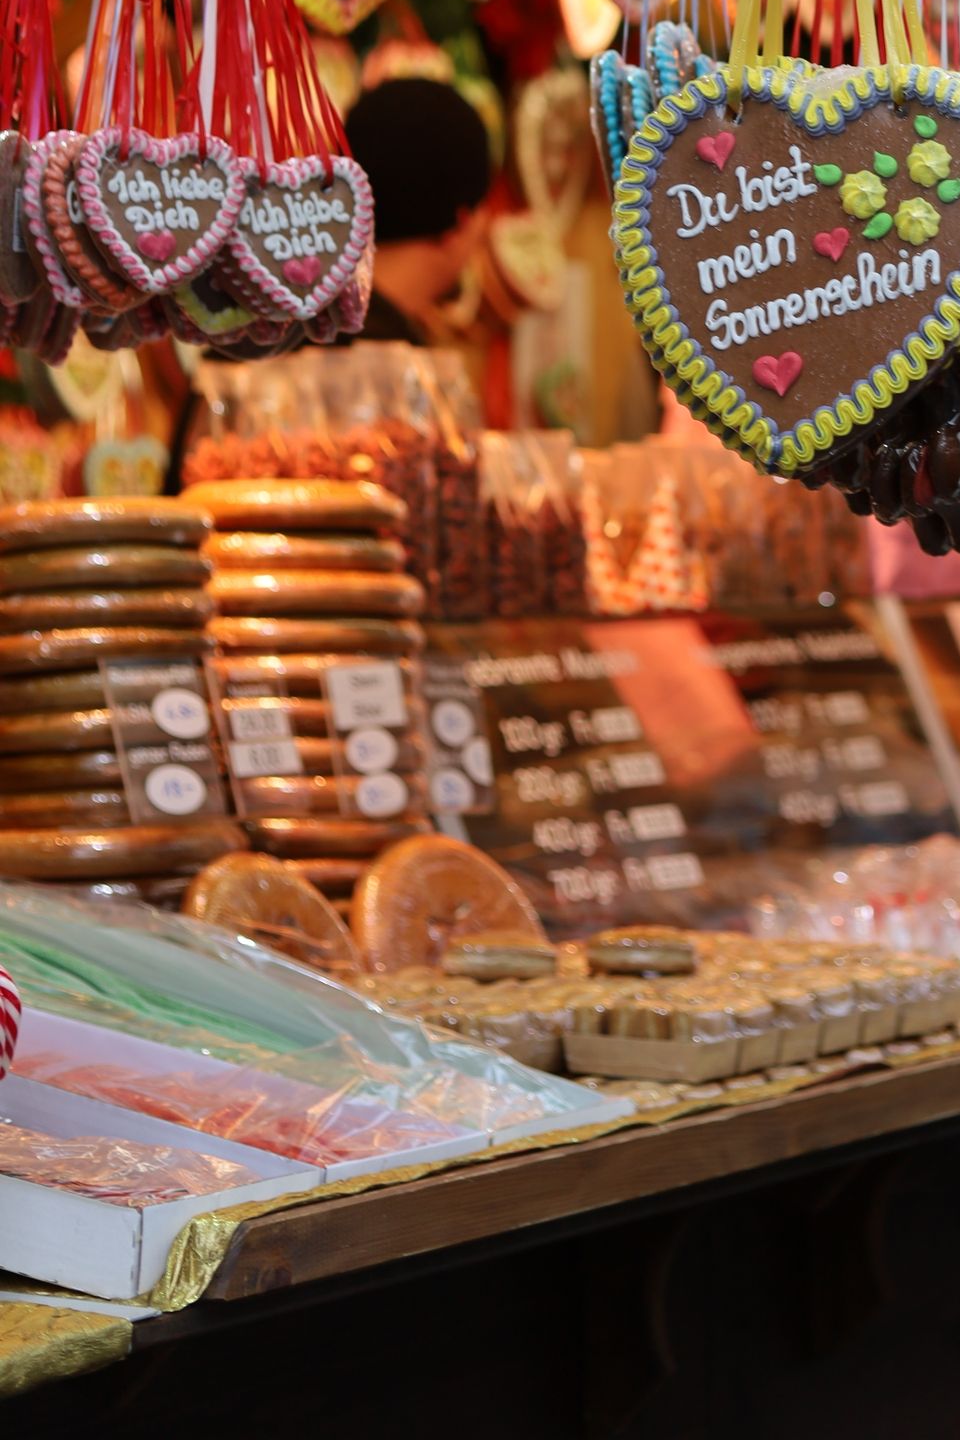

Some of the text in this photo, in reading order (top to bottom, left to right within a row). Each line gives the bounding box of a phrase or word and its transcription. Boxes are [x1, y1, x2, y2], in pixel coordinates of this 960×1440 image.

[108, 168, 225, 203] Ich liebe
[667, 146, 817, 238] Du bist
[124, 200, 200, 232] Dich
[239, 190, 350, 235] Ich liebe
[263, 226, 338, 260] Dich
[697, 227, 797, 294] mein
[705, 248, 942, 351] Sonnenschein
